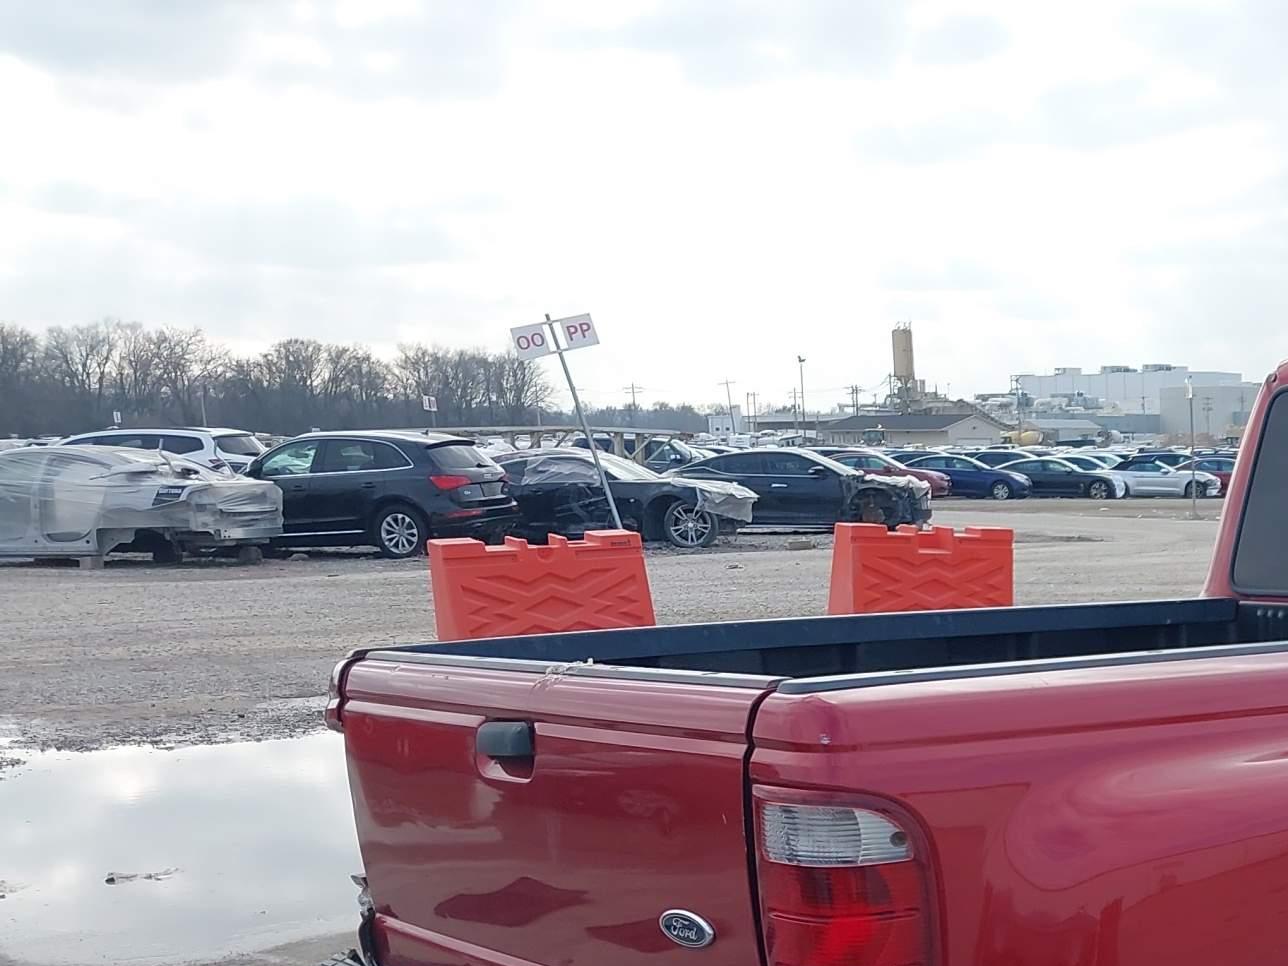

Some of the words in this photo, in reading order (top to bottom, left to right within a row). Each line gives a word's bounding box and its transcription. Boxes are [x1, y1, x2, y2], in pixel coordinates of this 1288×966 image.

[516, 332, 545, 350] OO
[566, 322, 591, 341] PP
[671, 917, 698, 941] Ford
